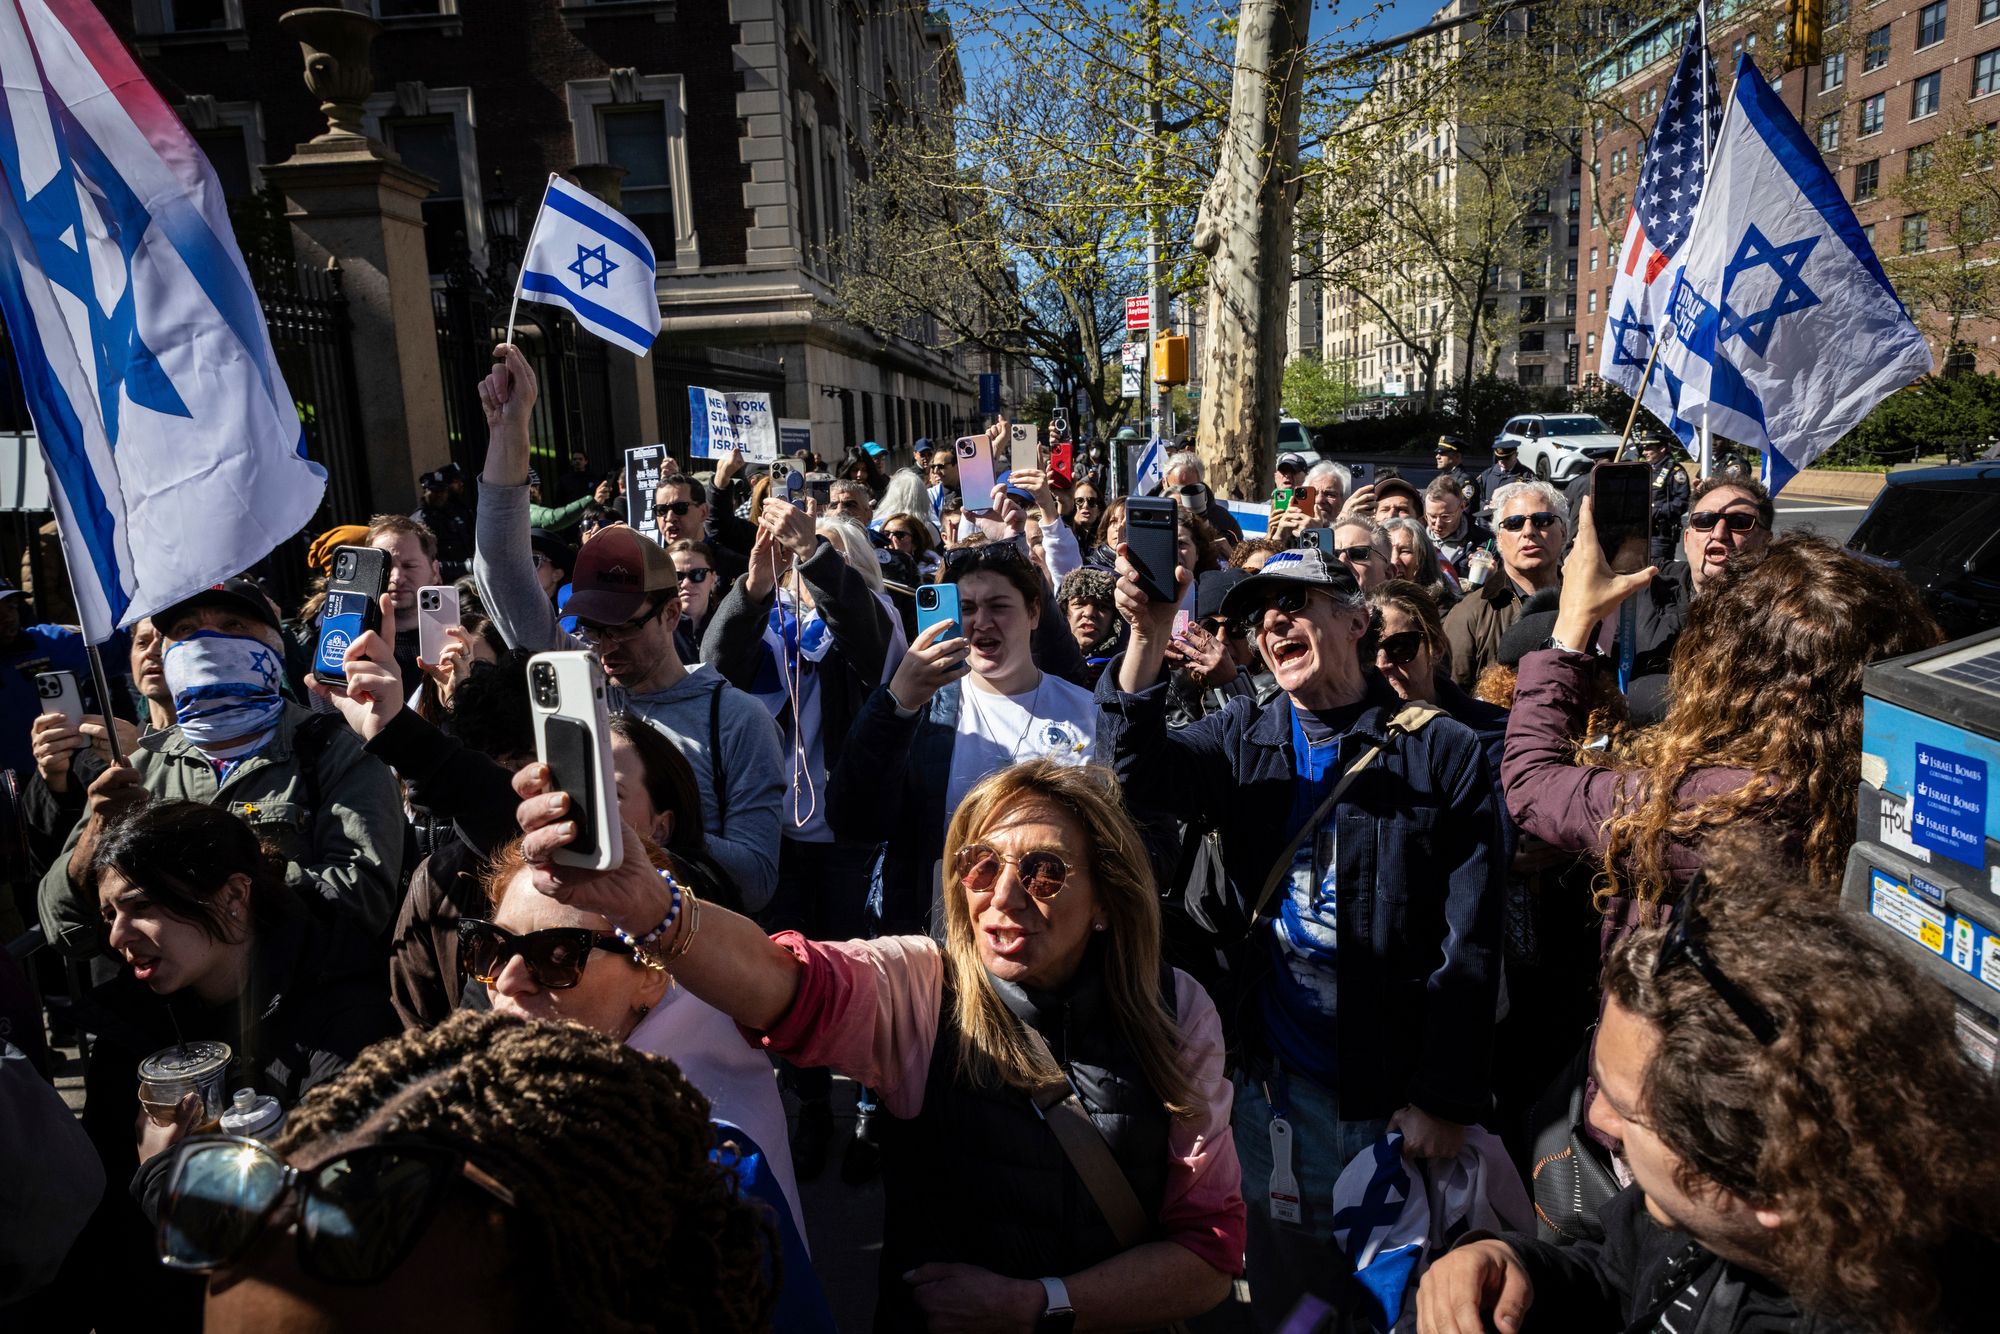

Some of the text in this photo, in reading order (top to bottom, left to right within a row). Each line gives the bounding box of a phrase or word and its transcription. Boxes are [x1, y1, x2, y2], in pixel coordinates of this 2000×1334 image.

[708, 397, 767, 412] NEW YORK
[711, 411, 752, 425] STANDS
[712, 425, 740, 439] WITH
[713, 439, 751, 453] ISRAEL
